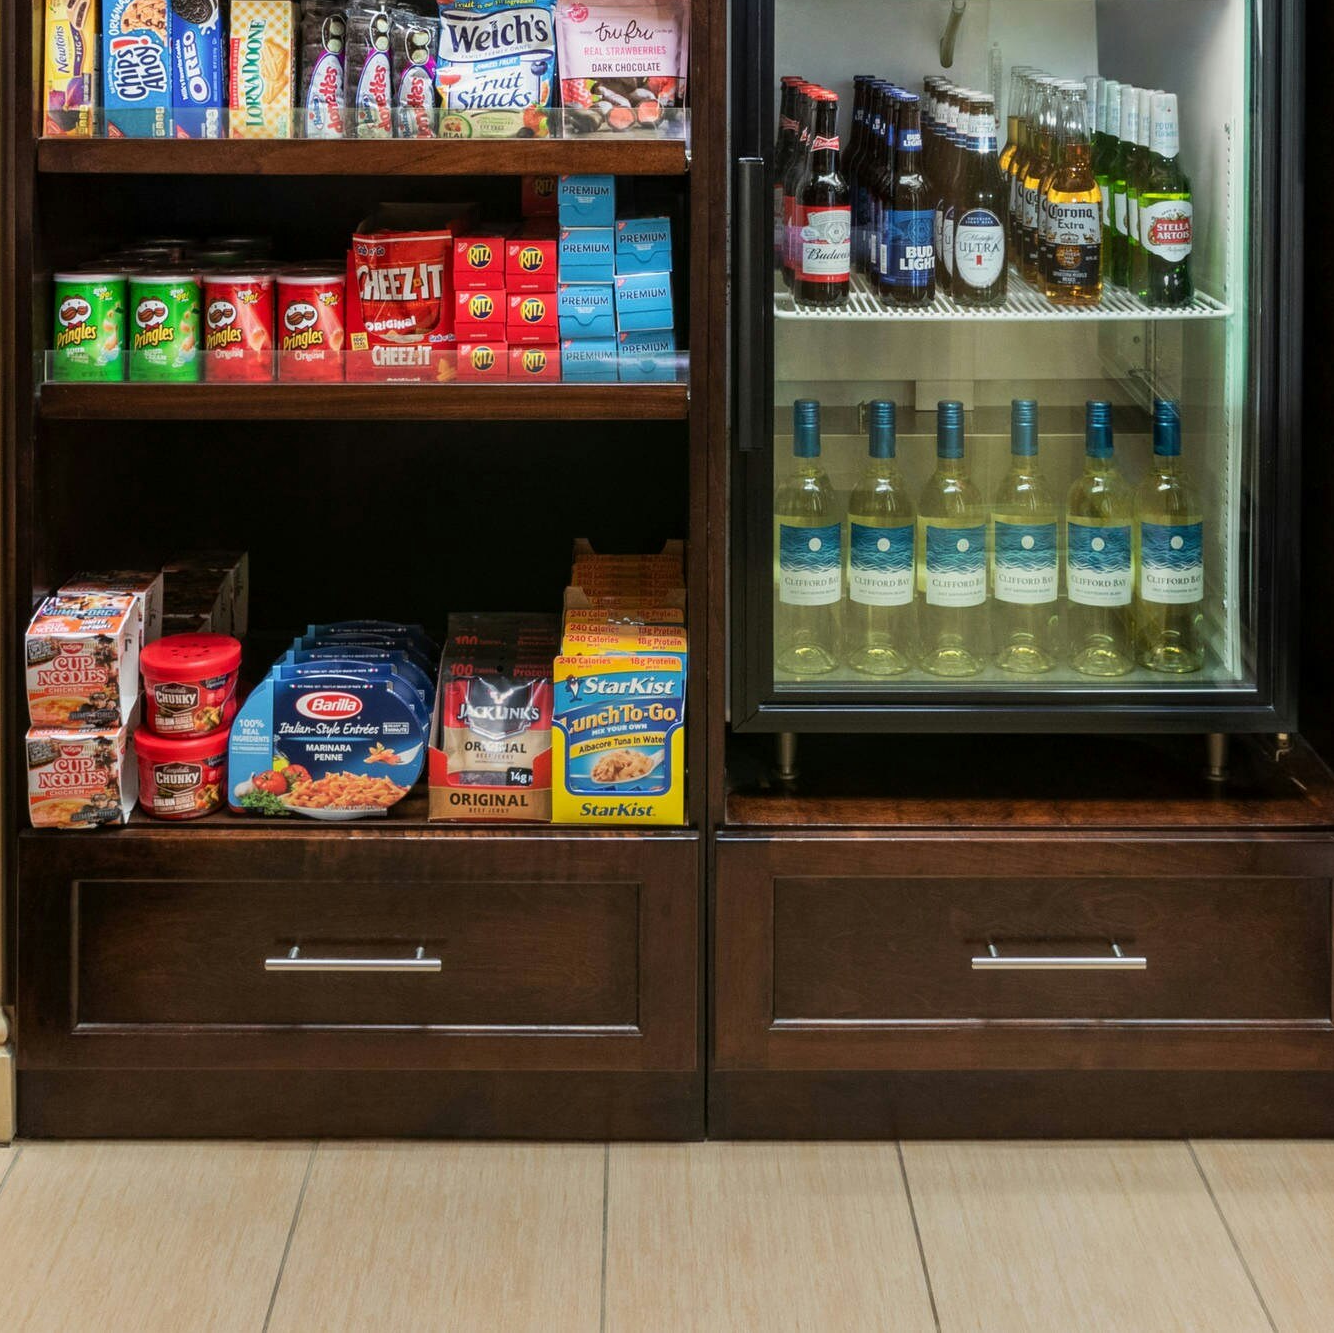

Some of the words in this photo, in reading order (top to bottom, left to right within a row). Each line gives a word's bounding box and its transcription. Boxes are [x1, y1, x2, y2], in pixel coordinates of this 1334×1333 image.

[454, 0, 475, 9] Fruit
[449, 12, 549, 53] Welch's
[58, 25, 70, 74] Newtons
[584, 46, 605, 56] REAL
[605, 45, 668, 55] STRAWBERRIES
[116, 48, 148, 100] Chips
[182, 30, 211, 104] OREO
[592, 63, 613, 73] DARK
[615, 62, 662, 72] CHOCOLATE
[319, 66, 344, 134] donettes
[369, 65, 392, 133] donettes
[456, 90, 532, 112] Snacks
[534, 177, 555, 194] RITZ
[562, 185, 610, 196] PREMIUM
[1048, 204, 1094, 219] Corona
[1057, 219, 1085, 230] Extra
[1156, 223, 1190, 231] STELLA
[619, 232, 667, 243] PREMIUM
[1156, 231, 1191, 240] ARTOIS
[562, 243, 610, 254] PREMIUM
[905, 246, 933, 257] BUD
[959, 243, 1000, 252] ULTRA
[468, 246, 492, 267] RITZ
[519, 249, 544, 270] RITZ
[561, 295, 609, 306] PREMIUM
[619, 288, 667, 300] PREMIUM
[469, 297, 493, 317] RITZ
[520, 300, 545, 321] RITZ
[56, 323, 97, 350] Pringles
[134, 326, 175, 352] Pringles
[206, 326, 242, 349] Pringles
[283, 327, 324, 352] Pringles
[294, 348, 325, 362] Original
[622, 342, 670, 354] PREMIUM
[470, 349, 494, 369] RITZ
[522, 352, 547, 371] RITZ
[566, 351, 613, 362] PREMIUM
[785, 577, 827, 587] CLIFFORD
[854, 576, 896, 587] CLIFFORD
[932, 578, 974, 588] CLIFFORD
[998, 575, 1041, 585] CLIFFORD
[1071, 576, 1112, 587] CLIFFORD
[1146, 575, 1190, 586] CLIFFORD
[570, 624, 587, 632] 240
[569, 635, 586, 643] 240
[587, 635, 619, 644] Calories
[637, 638, 652, 646] 18g
[653, 637, 682, 646] Protein
[53, 655, 95, 671] CUP
[558, 657, 577, 665] 240
[578, 656, 611, 665] Calories
[630, 657, 645, 666] 18g
[647, 657, 676, 666] Protein
[37, 668, 108, 686] NOODLES
[48, 686, 84, 694] CHICKEN
[583, 676, 676, 695] StarKist
[155, 691, 197, 705] CHUNKY
[311, 697, 357, 712] Barilla
[239, 719, 265, 728] 100%
[278, 722, 341, 739] Italian-Style
[343, 722, 380, 735] Entrées
[591, 726, 605, 736] MIX
[607, 725, 627, 734] YOUR
[628, 723, 647, 732] OWN
[243, 728, 260, 736] REAL
[305, 744, 352, 753] MARINARA
[578, 740, 612, 755] Albacore
[613, 737, 631, 747] Tuna
[314, 753, 344, 762] PENNE
[53, 757, 96, 774] CUP
[37, 770, 109, 788] NOODLES
[155, 771, 199, 784] CHUNKY
[510, 770, 527, 784] 14g
[449, 792, 529, 807] ORIGINAL
[580, 802, 654, 817] StarKist
